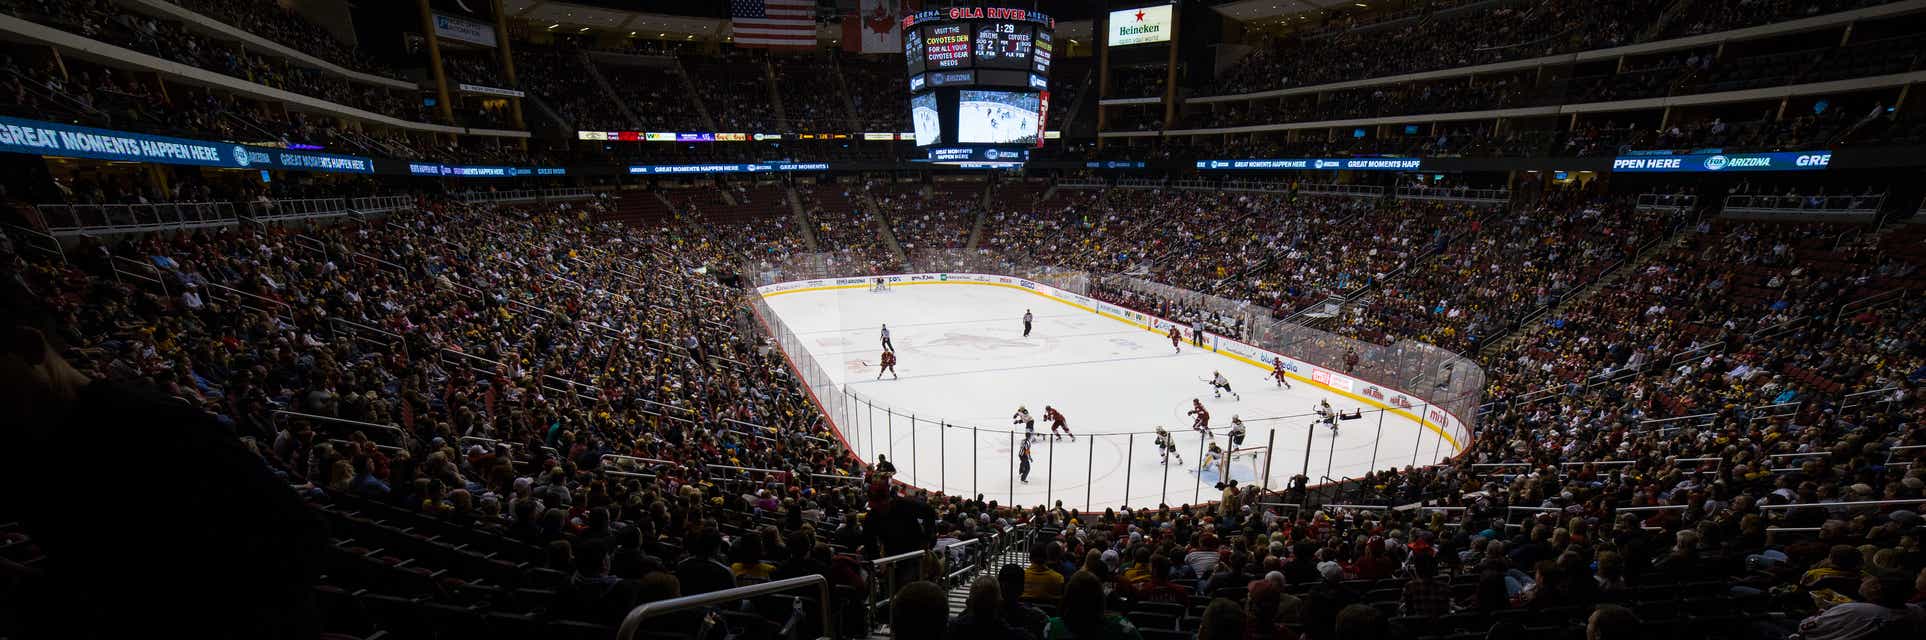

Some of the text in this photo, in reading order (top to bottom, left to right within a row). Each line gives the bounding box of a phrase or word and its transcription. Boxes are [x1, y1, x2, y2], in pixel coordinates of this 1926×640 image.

[950, 7, 1026, 20] GILA RIVER
[996, 24, 1014, 33] 1:29
[1120, 24, 1160, 36] Heineken
[927, 36, 956, 45] COYOTES
[987, 40, 993, 49] 2
[1015, 42, 1019, 50] 1
[0, 124, 220, 161] GREAT MOMENTS HAPPEN HERE
[1614, 158, 1681, 169] PPEN HERE
[1728, 157, 1771, 167] ARIZONA
[1796, 154, 1832, 166] GRE
